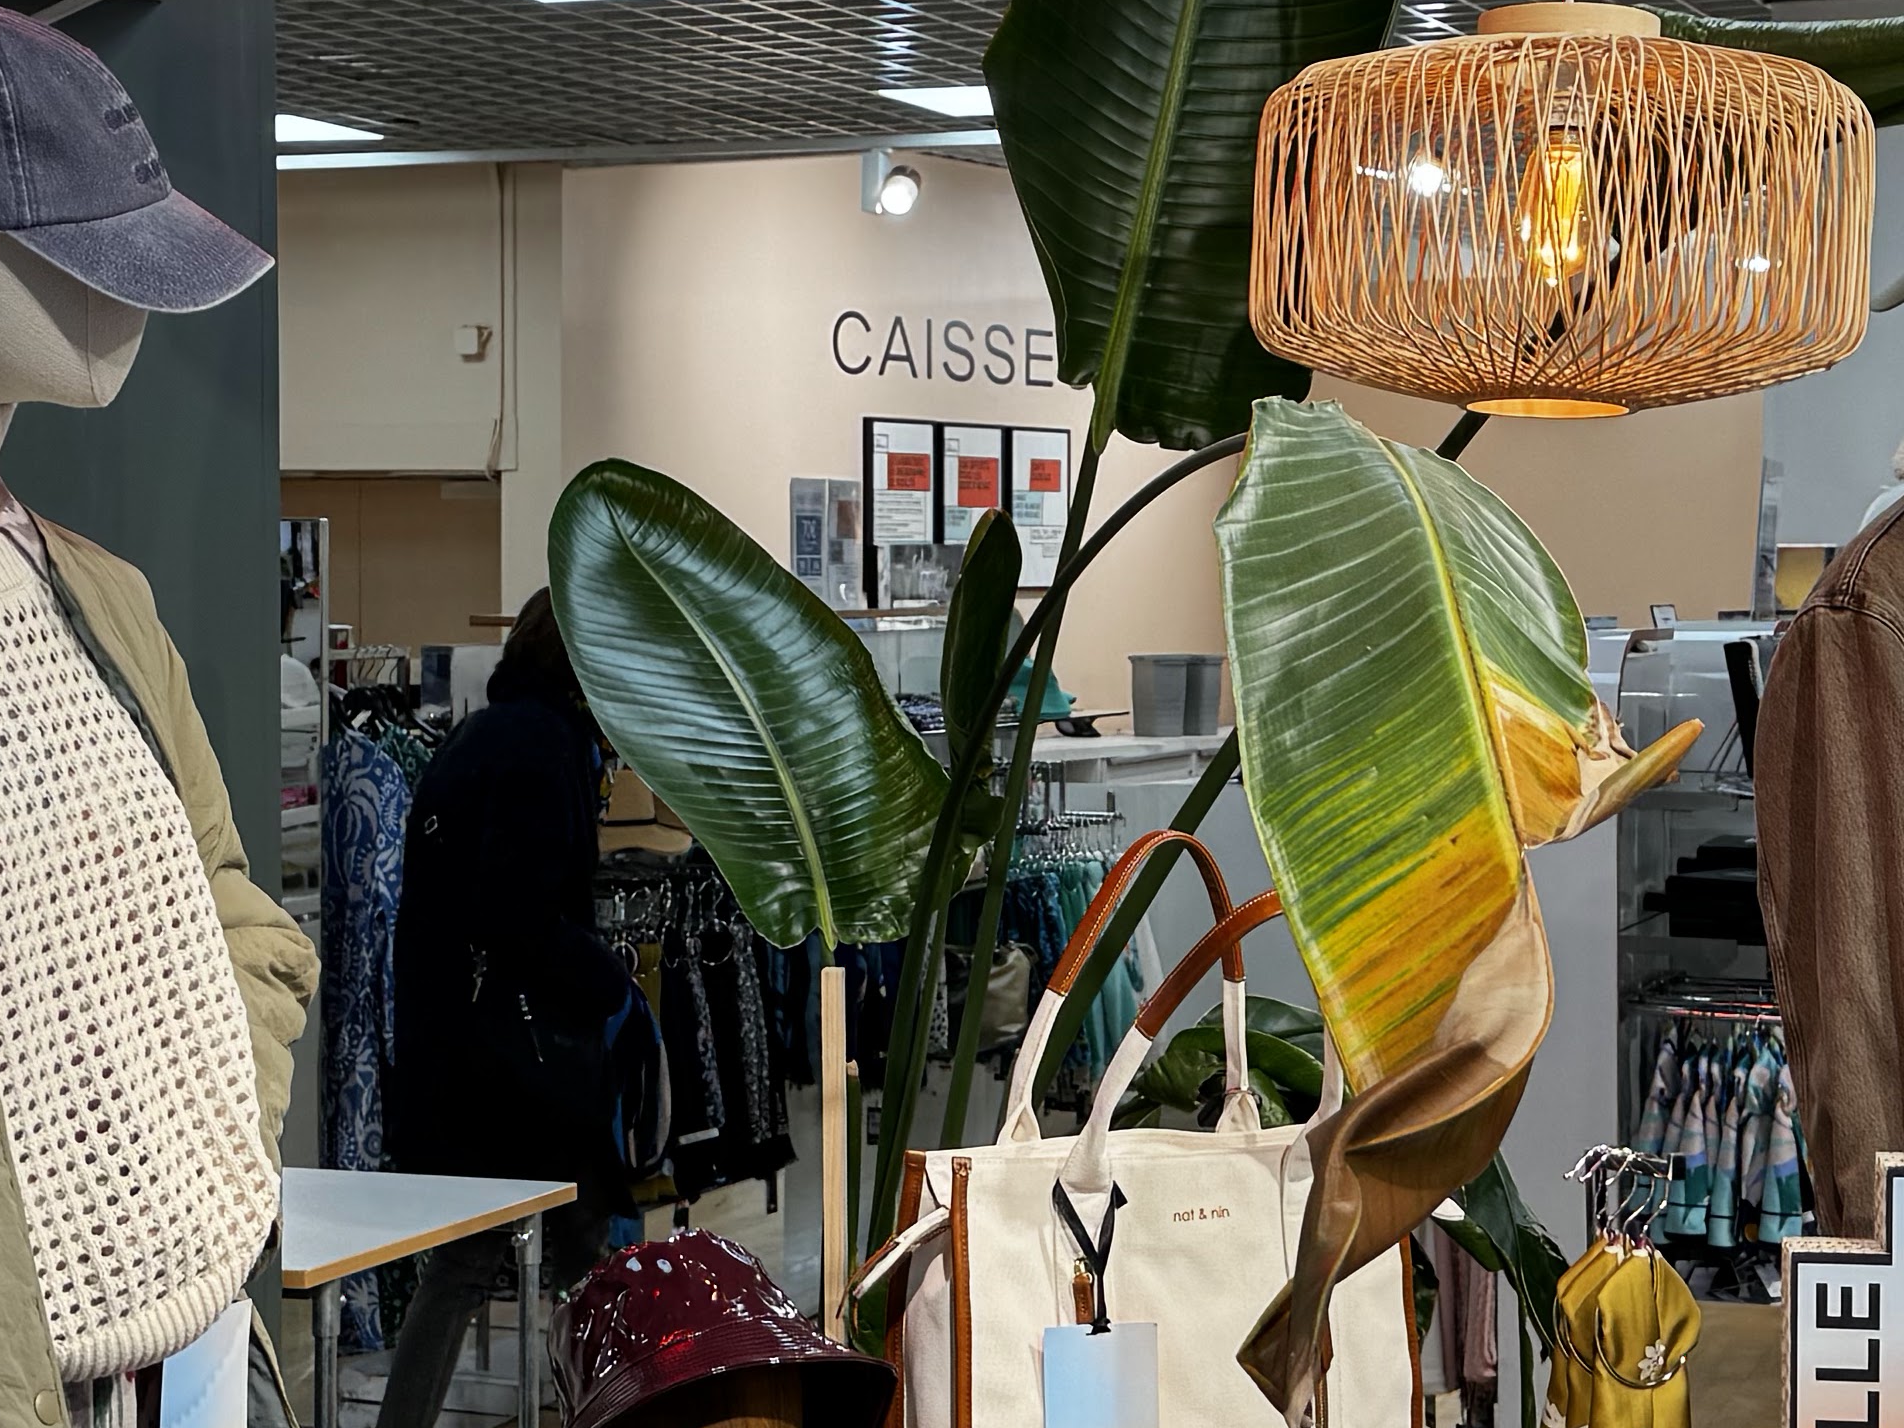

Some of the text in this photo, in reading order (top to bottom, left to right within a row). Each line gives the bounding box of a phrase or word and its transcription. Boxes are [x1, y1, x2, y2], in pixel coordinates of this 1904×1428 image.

[832, 310, 1054, 388] CAISSE
[1173, 1206, 1230, 1222] nat & nin
